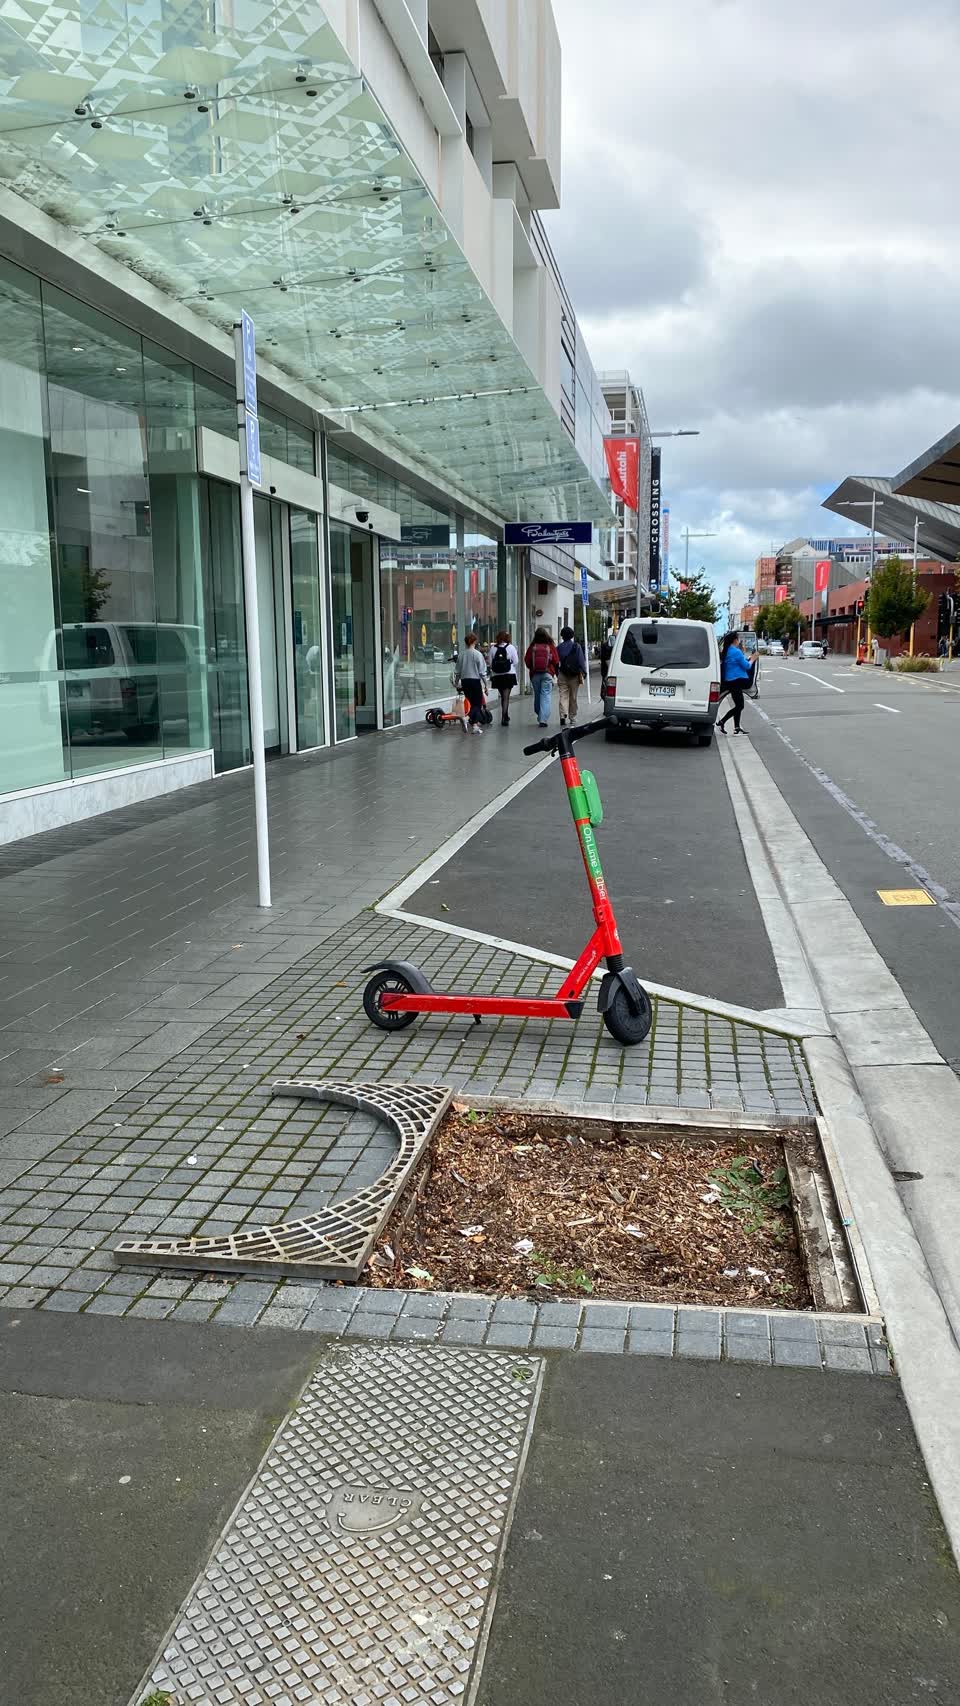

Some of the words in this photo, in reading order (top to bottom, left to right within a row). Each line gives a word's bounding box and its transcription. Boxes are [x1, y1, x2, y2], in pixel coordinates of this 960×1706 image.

[651, 479, 660, 543] CROSSING
[583, 827, 592, 841] On
[586, 841, 598, 868] Lime
[596, 876, 607, 900] Uber
[343, 1493, 412, 1507] CLEAR
